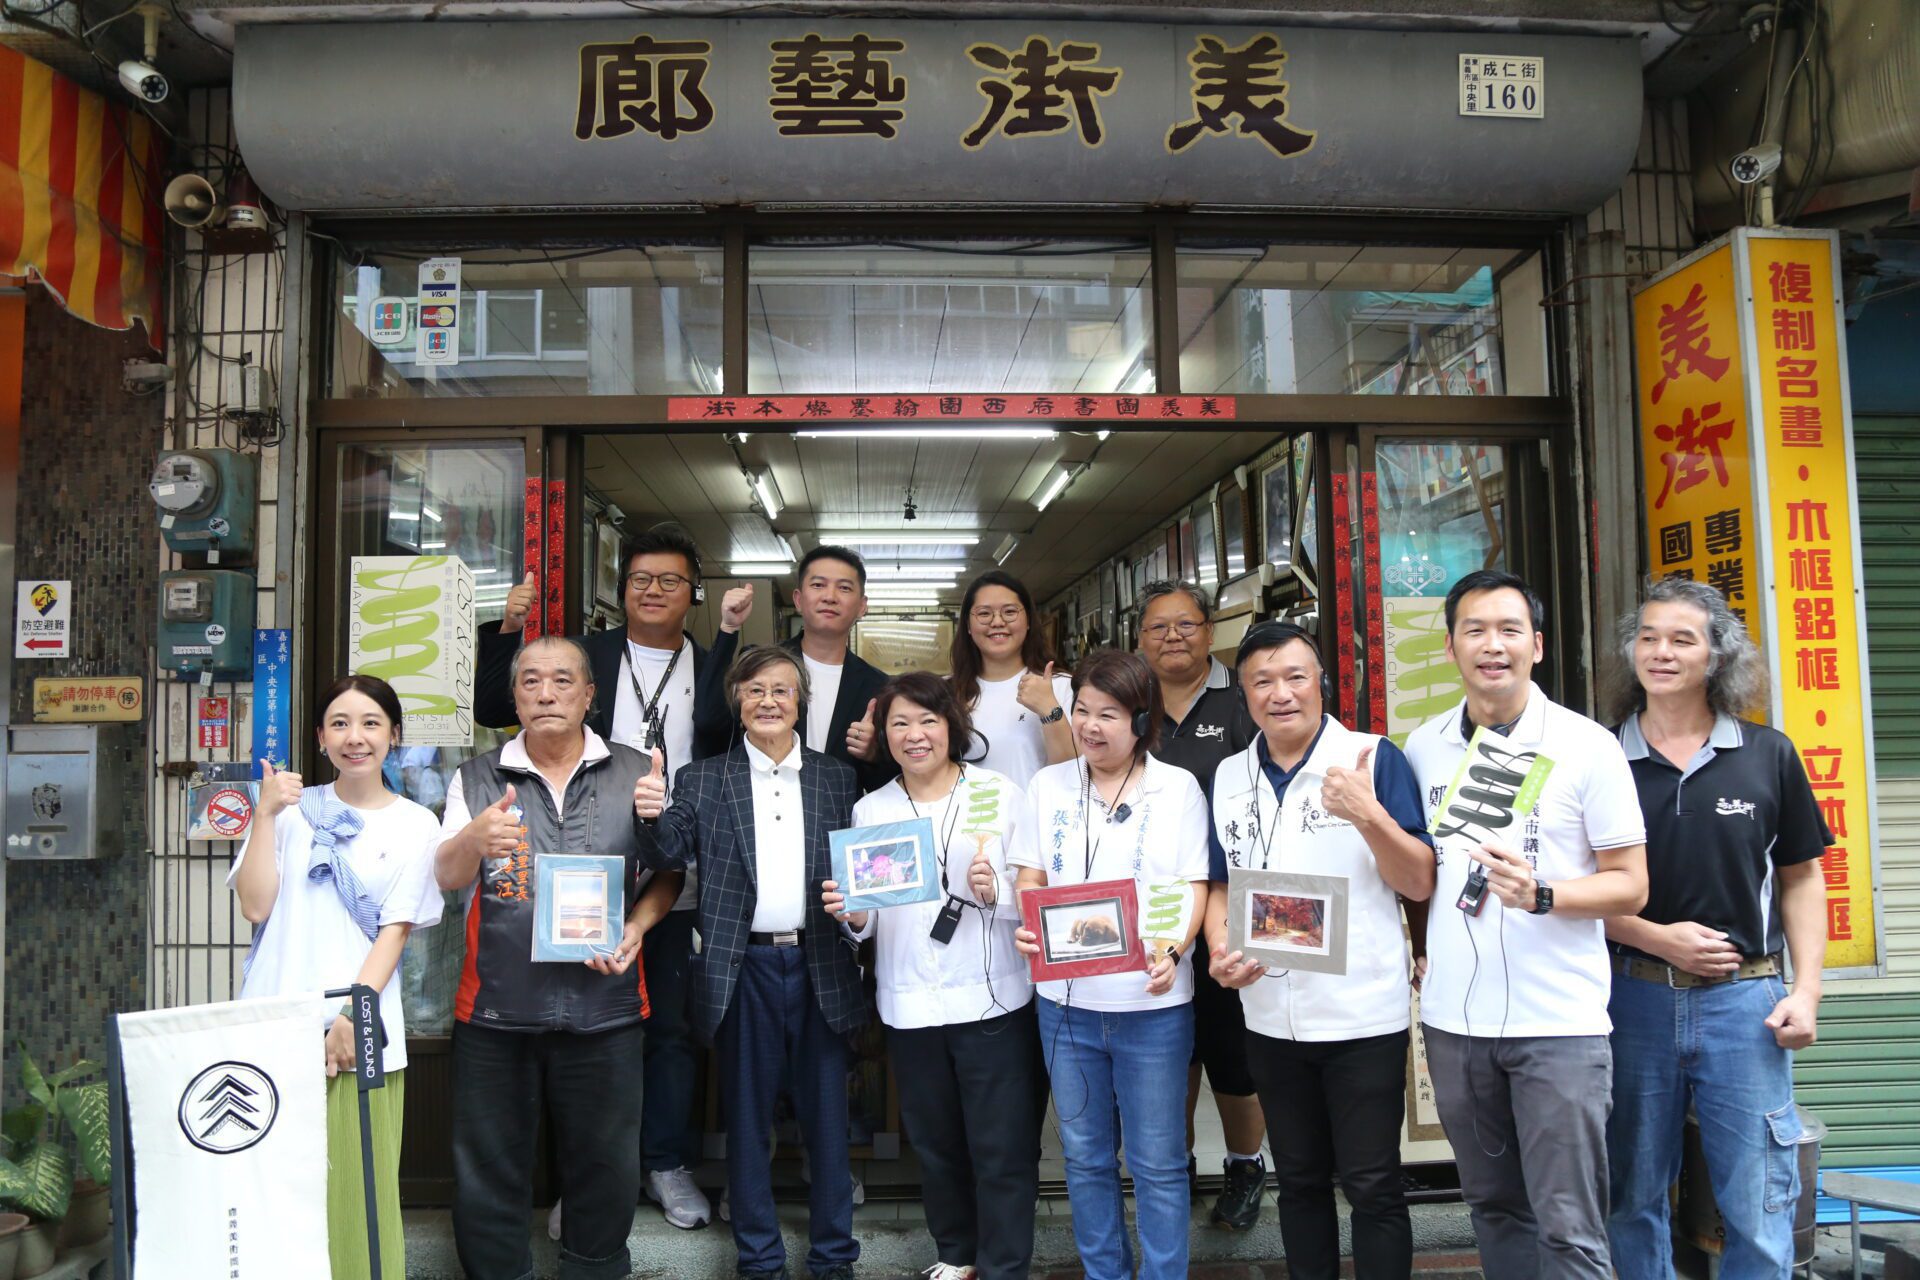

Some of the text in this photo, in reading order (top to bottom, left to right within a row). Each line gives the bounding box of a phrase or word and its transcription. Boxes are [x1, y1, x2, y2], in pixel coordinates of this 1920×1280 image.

[1483, 61, 1537, 79] 成仁街
[1466, 83, 1478, 112] 中央里
[1484, 83, 1537, 111] 160
[1650, 282, 1736, 510] 美街
[456, 563, 473, 633] LOST
[21, 619, 65, 631] 防空避難
[351, 621, 362, 657] CITY
[257, 631, 268, 665] 東區
[278, 631, 289, 665] 嘉義市
[63, 686, 117, 701] 請勿停車
[455, 649, 472, 736] FOUND
[1387, 661, 1398, 696] CITY
[72, 704, 106, 713] 謝謝合作
[121, 691, 135, 705] 停
[1052, 809, 1070, 875] 張秀華
[515, 824, 530, 903] 中央里里長
[361, 995, 376, 1079] LOST & FOUND
